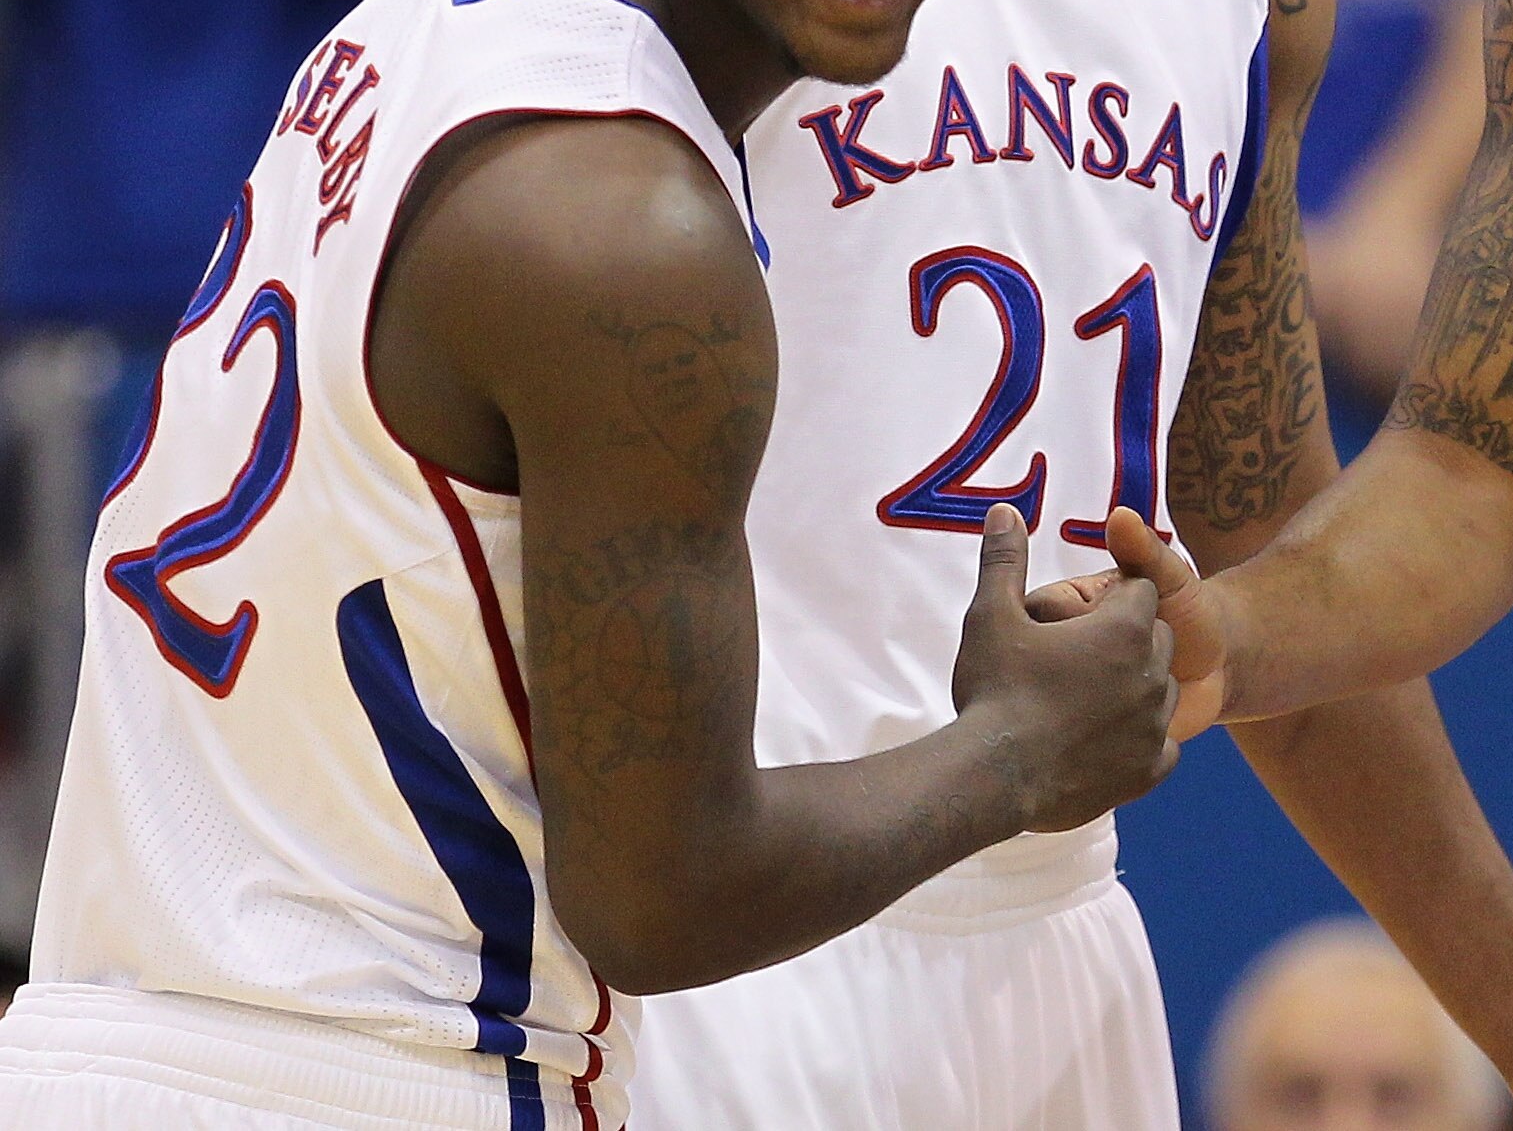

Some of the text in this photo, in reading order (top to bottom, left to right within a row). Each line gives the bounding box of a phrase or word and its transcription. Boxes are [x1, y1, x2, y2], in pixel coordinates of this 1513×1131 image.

[277, 38, 381, 259] SELBY
[800, 62, 1228, 242] KANSAS
[876, 245, 1172, 550] 21
